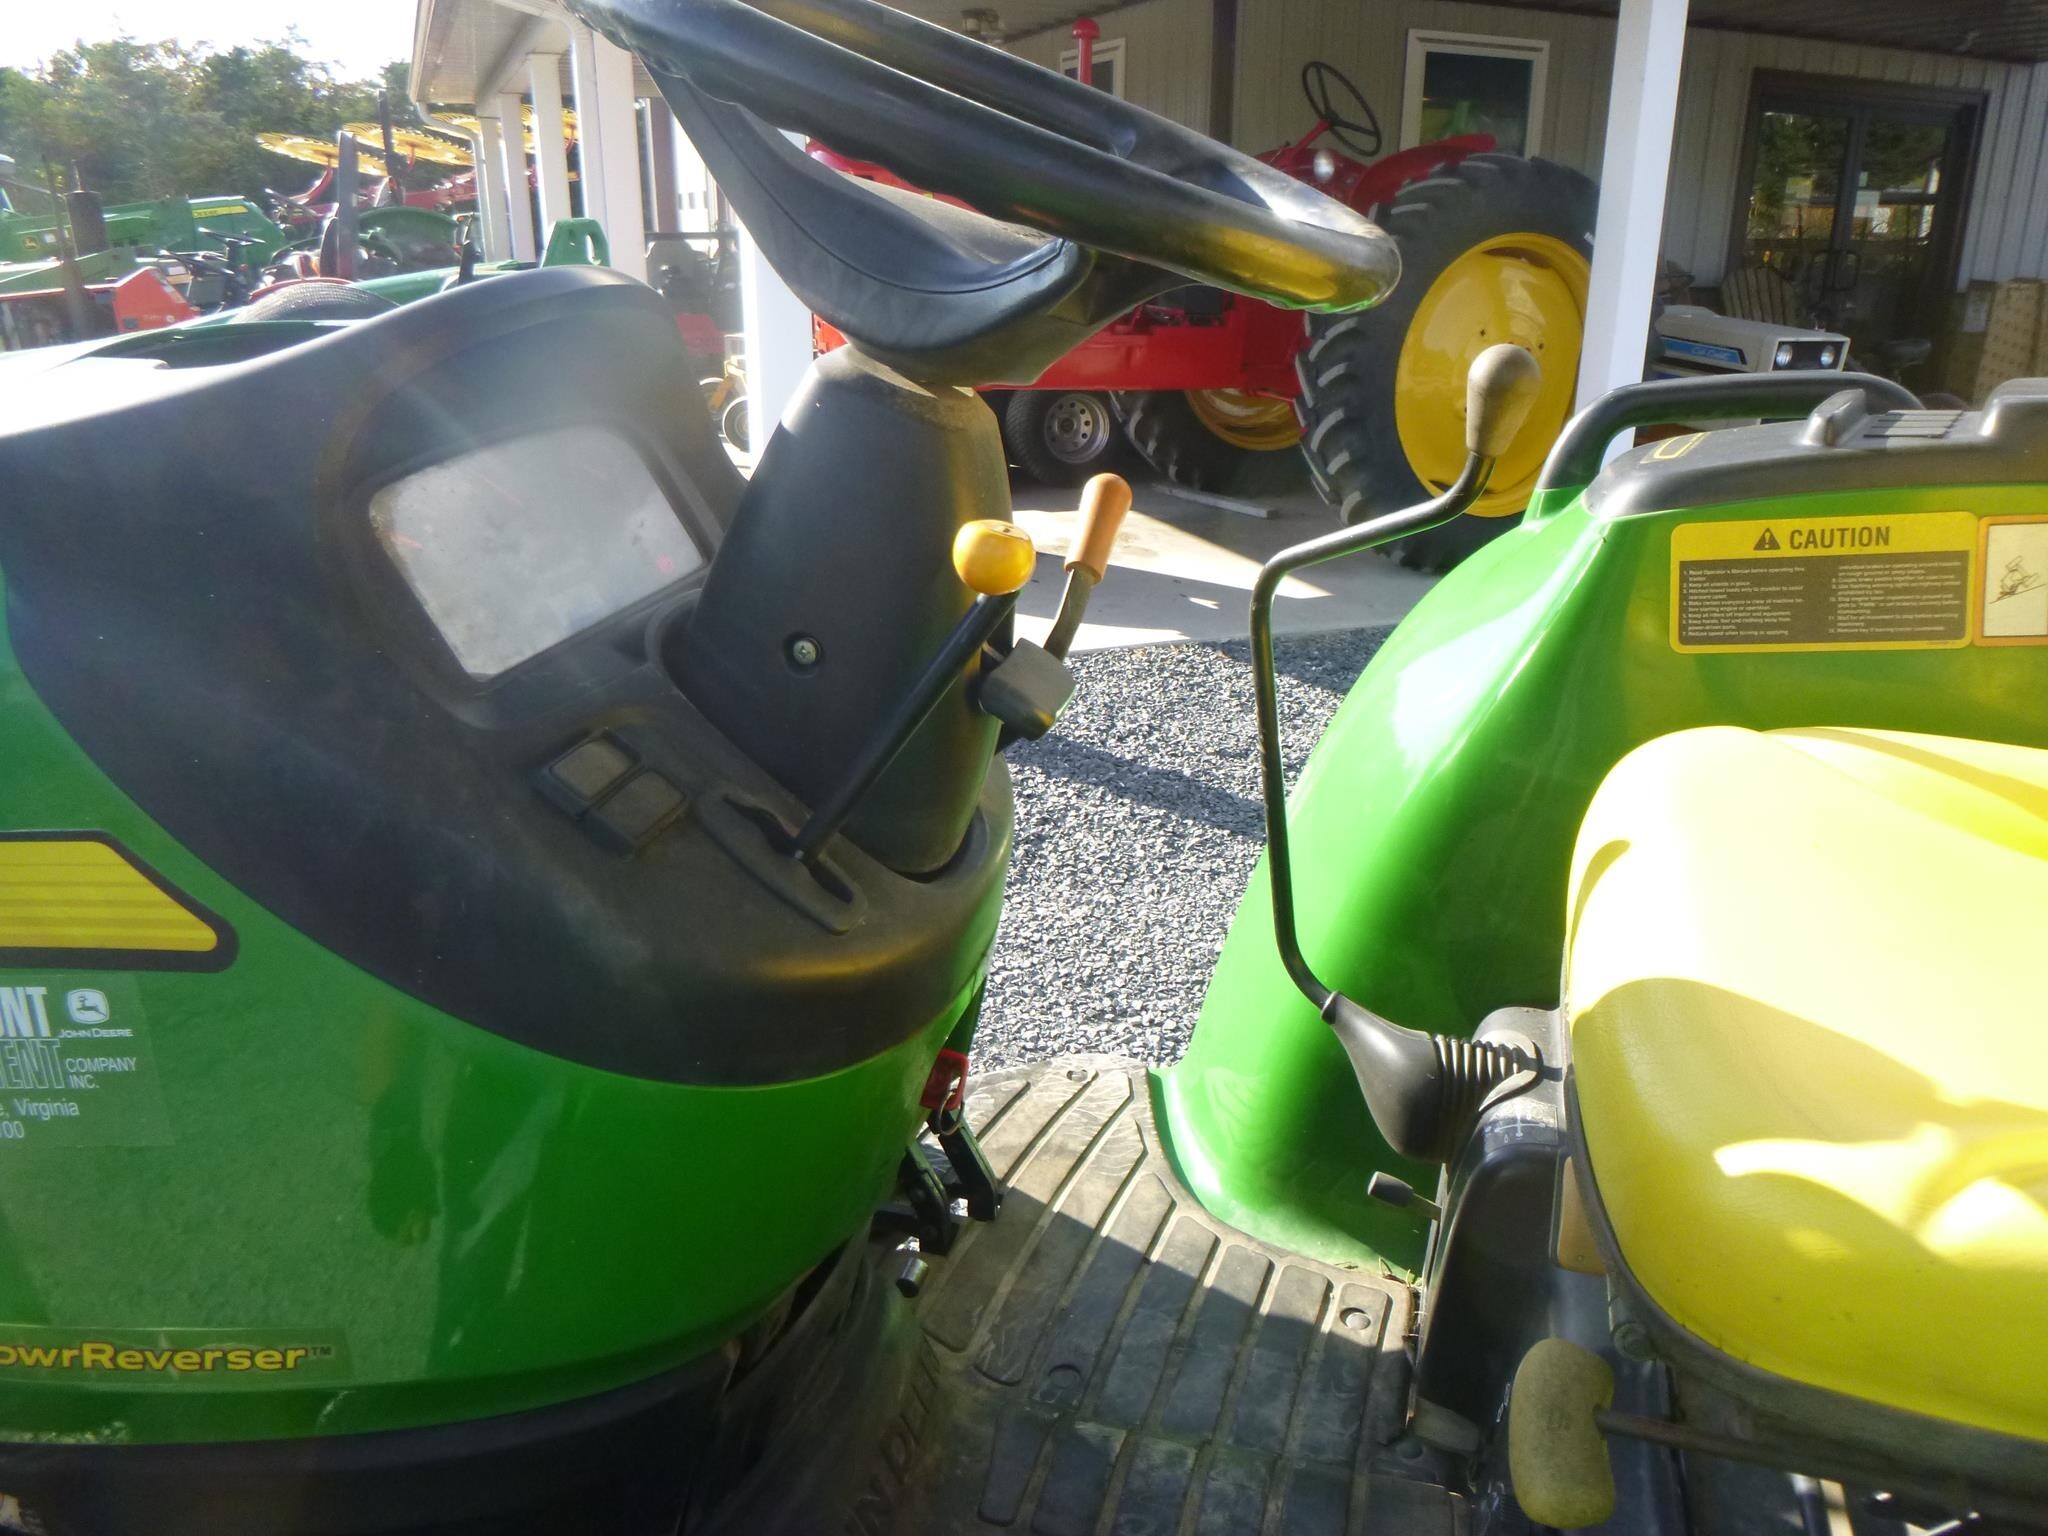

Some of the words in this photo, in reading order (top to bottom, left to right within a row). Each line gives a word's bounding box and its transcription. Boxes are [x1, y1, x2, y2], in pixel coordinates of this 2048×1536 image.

[1789, 525, 1890, 550] CAUTION
[0, 986, 51, 1038] NT
[92, 1027, 134, 1038] DEERE
[0, 1038, 65, 1089] ENT
[65, 1057, 137, 1073] COMPANY
[69, 1074, 100, 1089] INC.
[14, 1097, 81, 1121] Virginia
[0, 1120, 25, 1139] 00
